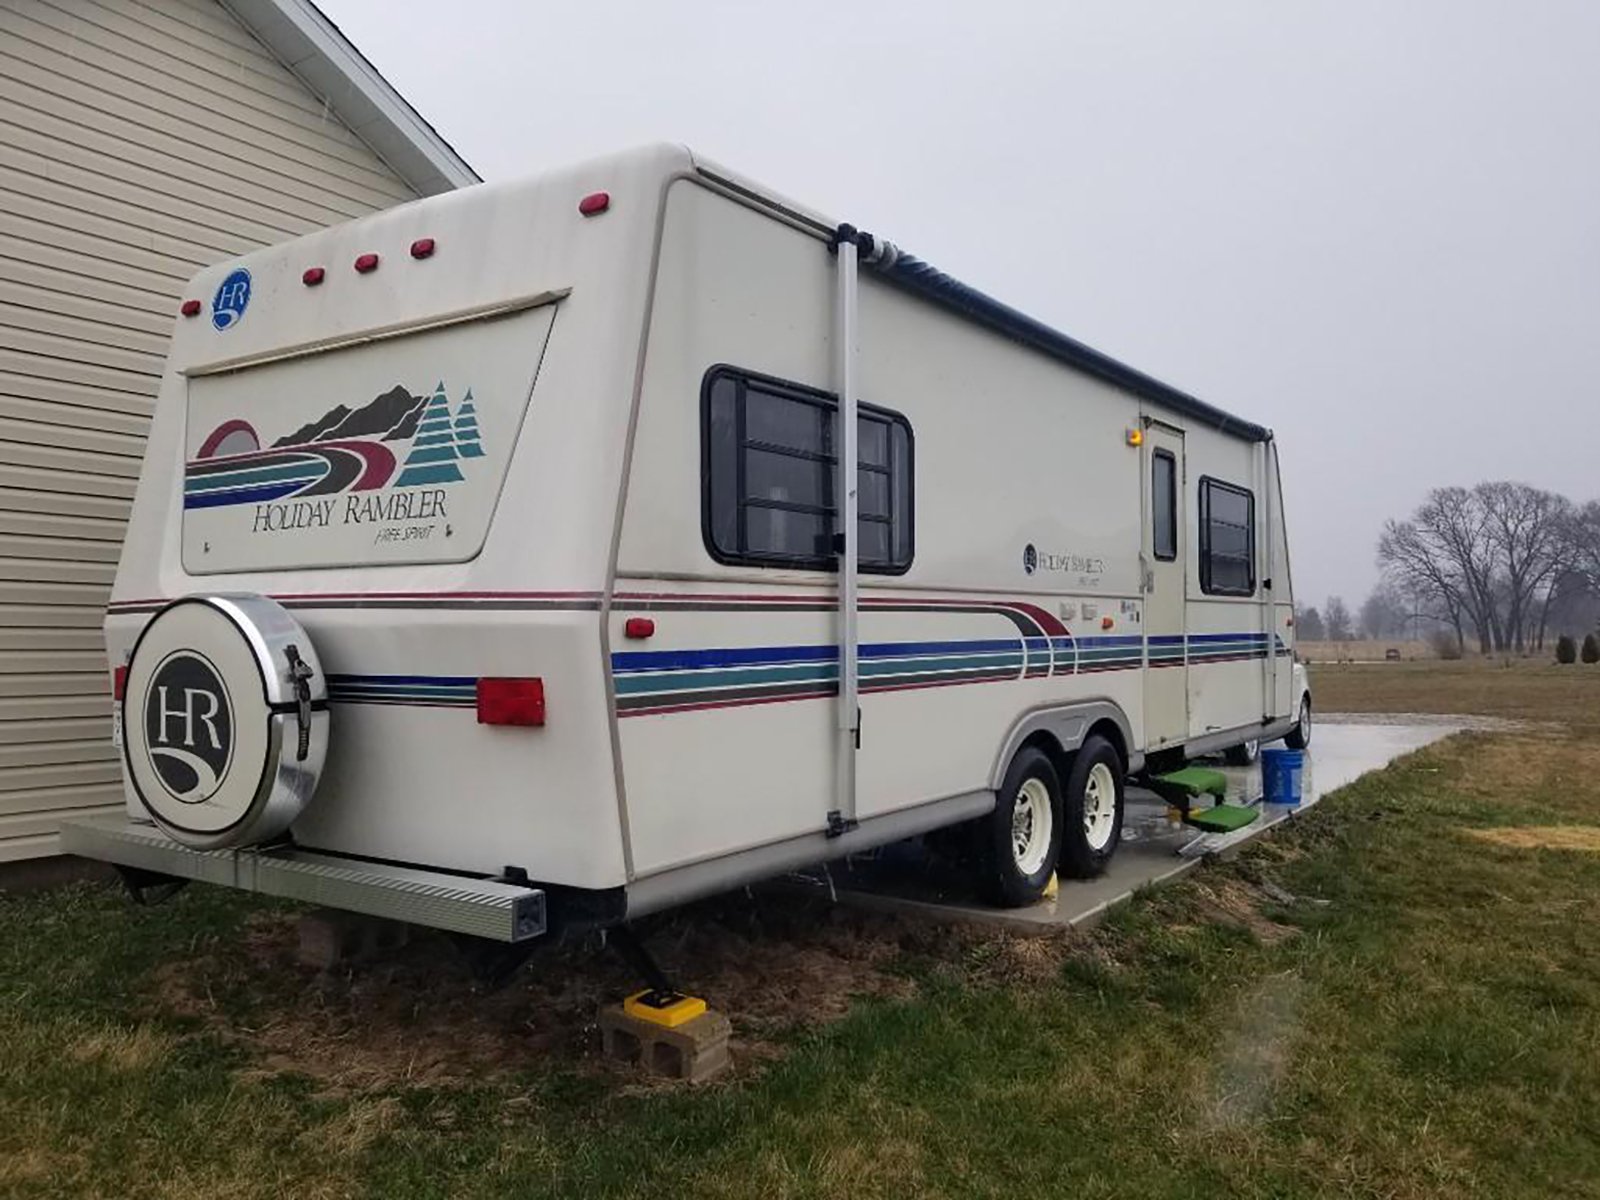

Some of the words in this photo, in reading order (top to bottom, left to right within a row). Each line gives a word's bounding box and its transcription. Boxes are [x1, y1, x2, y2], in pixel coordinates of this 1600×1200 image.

[218, 281, 248, 310] HR
[252, 499, 337, 533] HOLIDAY
[343, 489, 447, 525] RAMBLER
[157, 685, 223, 750] HR
